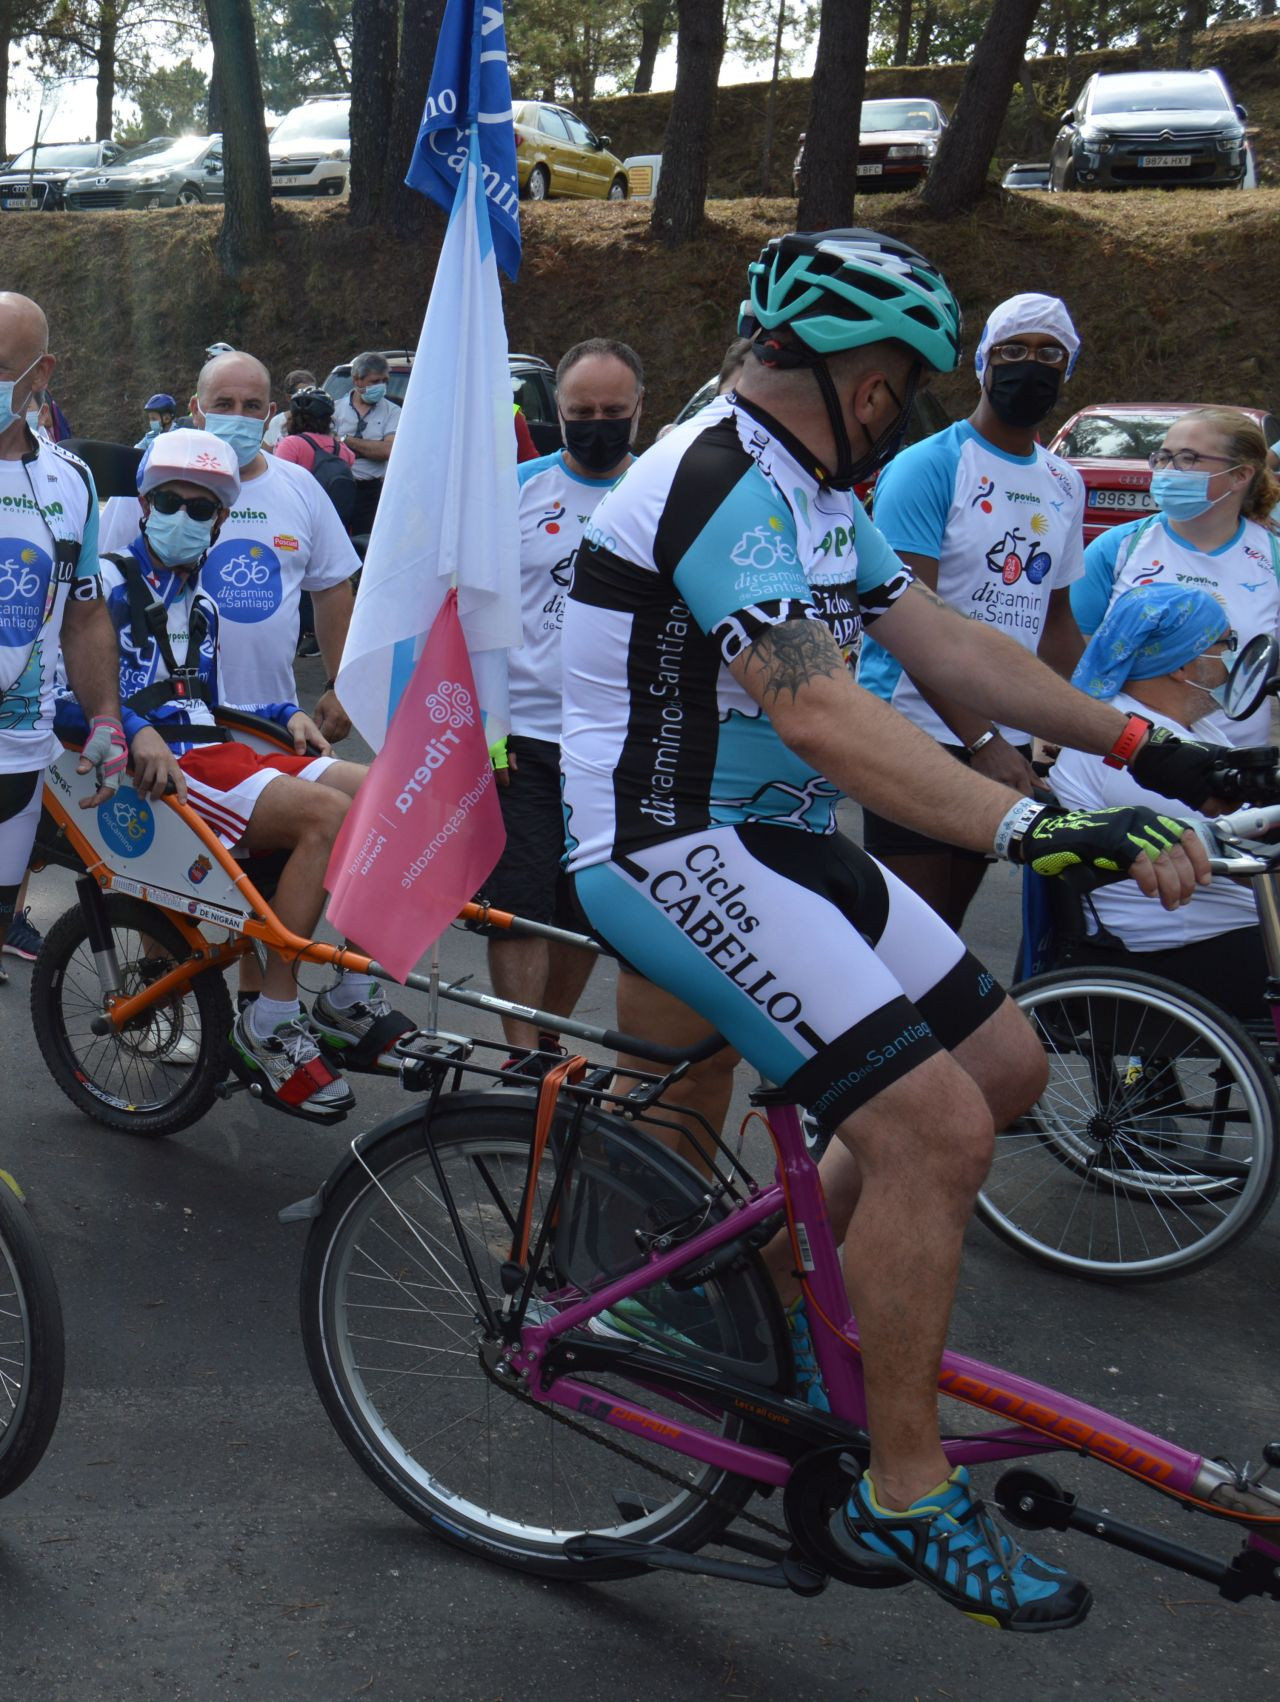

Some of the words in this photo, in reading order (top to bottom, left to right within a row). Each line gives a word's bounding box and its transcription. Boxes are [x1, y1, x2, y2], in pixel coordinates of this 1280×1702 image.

[1097, 491, 1136, 506] 9963
[230, 508, 267, 520] ovisa
[217, 587, 274, 598] discamino
[226, 599, 275, 611] Santiago
[685, 844, 760, 934] Ciclos
[650, 870, 802, 1023] CABELLO
